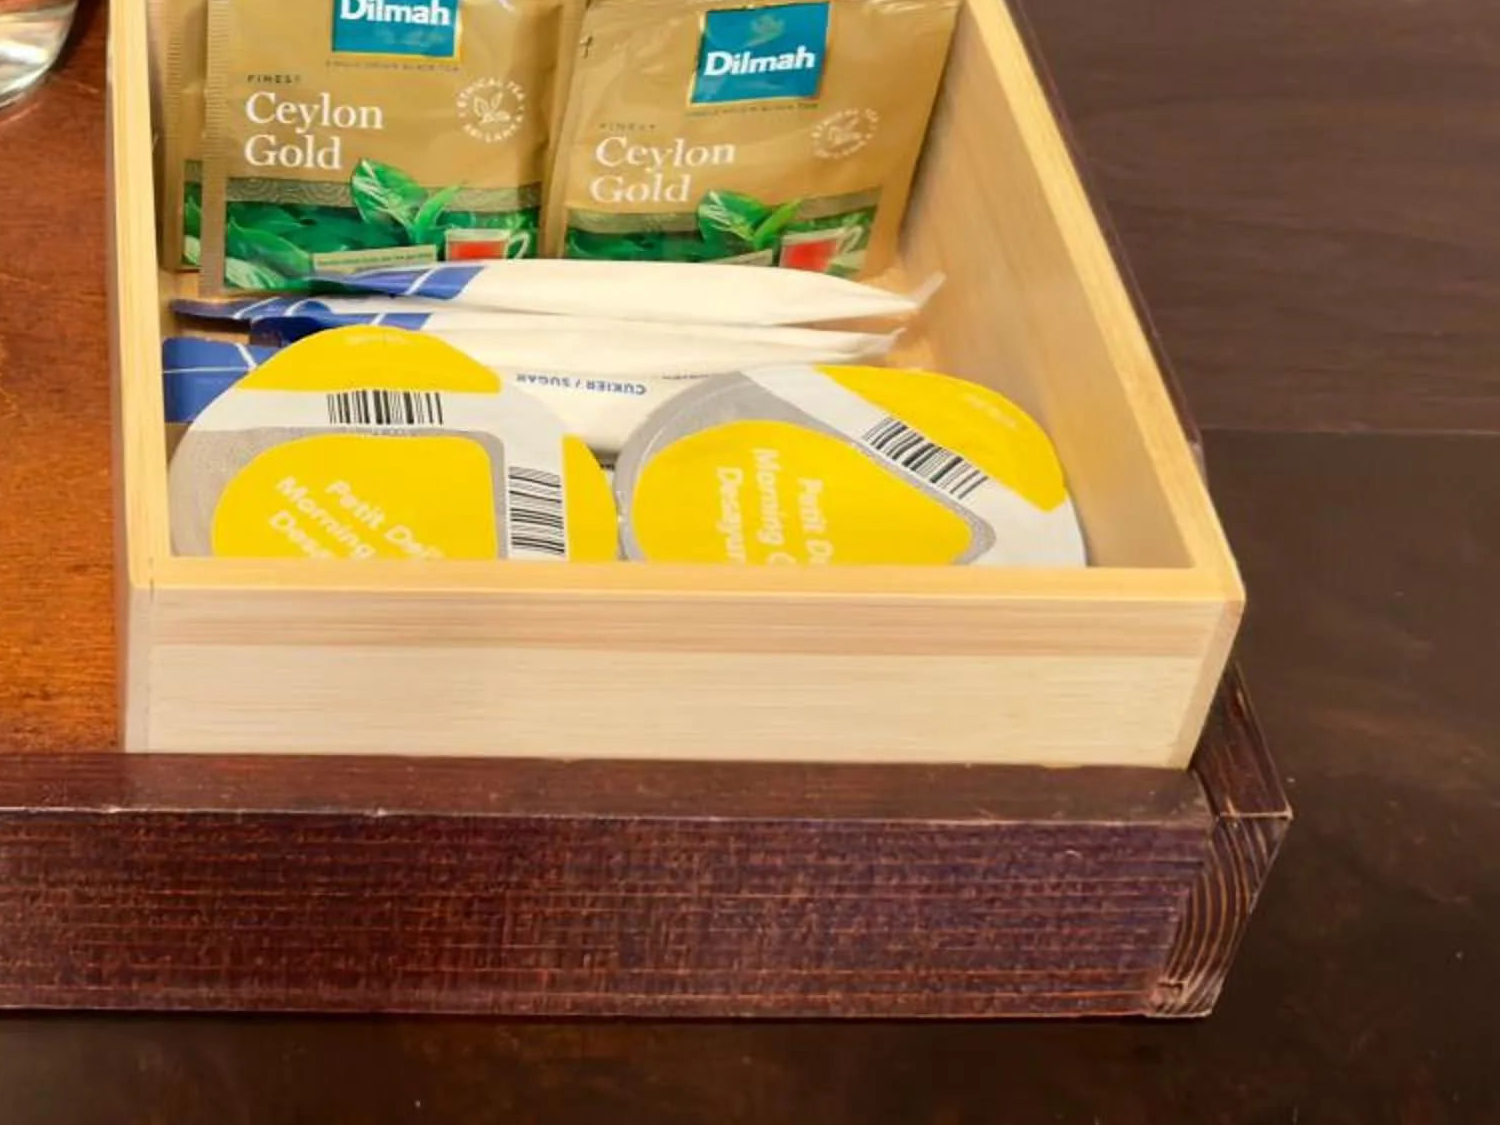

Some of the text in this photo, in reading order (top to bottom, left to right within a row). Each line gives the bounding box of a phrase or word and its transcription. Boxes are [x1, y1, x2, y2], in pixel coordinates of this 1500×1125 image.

[702, 45, 817, 77] Dilmah
[244, 90, 384, 135] Ceylon
[243, 133, 343, 171] Gold
[595, 135, 737, 173] Ceylon
[589, 173, 692, 204] Gold
[515, 372, 571, 388] SUGAR
[586, 379, 648, 396] CUKIER
[324, 479, 386, 531] Petit
[752, 447, 786, 547] Morning
[796, 477, 828, 535] Petit
[275, 475, 377, 560] Morning
